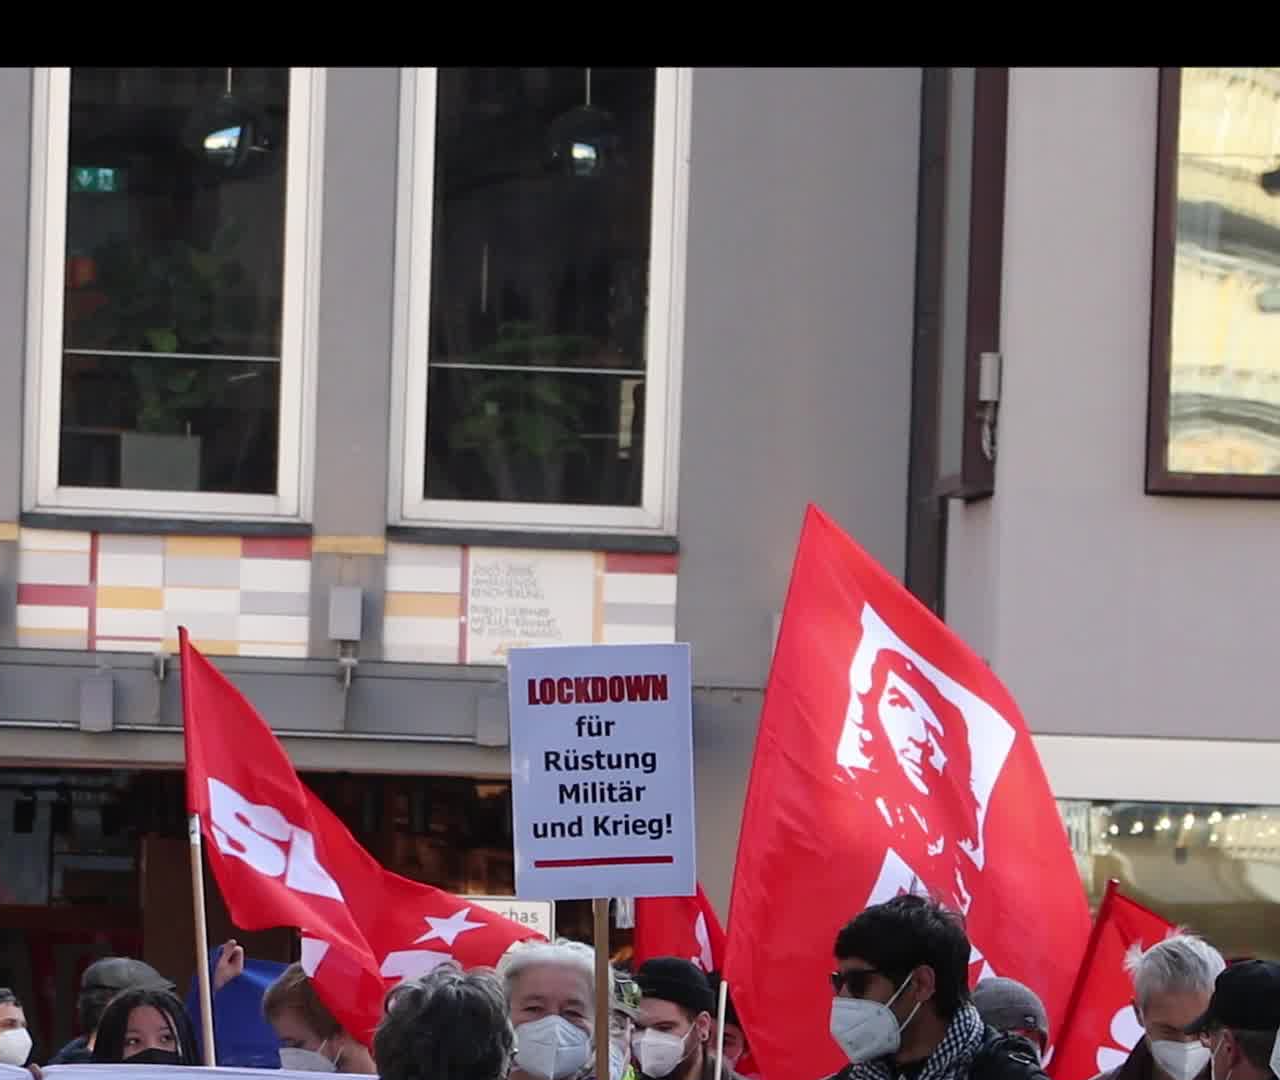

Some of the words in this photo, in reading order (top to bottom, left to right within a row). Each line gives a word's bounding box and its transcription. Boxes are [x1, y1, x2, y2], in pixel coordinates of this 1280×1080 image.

[527, 674, 669, 706] LOCKDOWN
[575, 715, 616, 738] für
[543, 749, 658, 774] Rüstung
[558, 780, 647, 805] Militär
[532, 815, 584, 839] und
[593, 813, 673, 840] Krieg!
